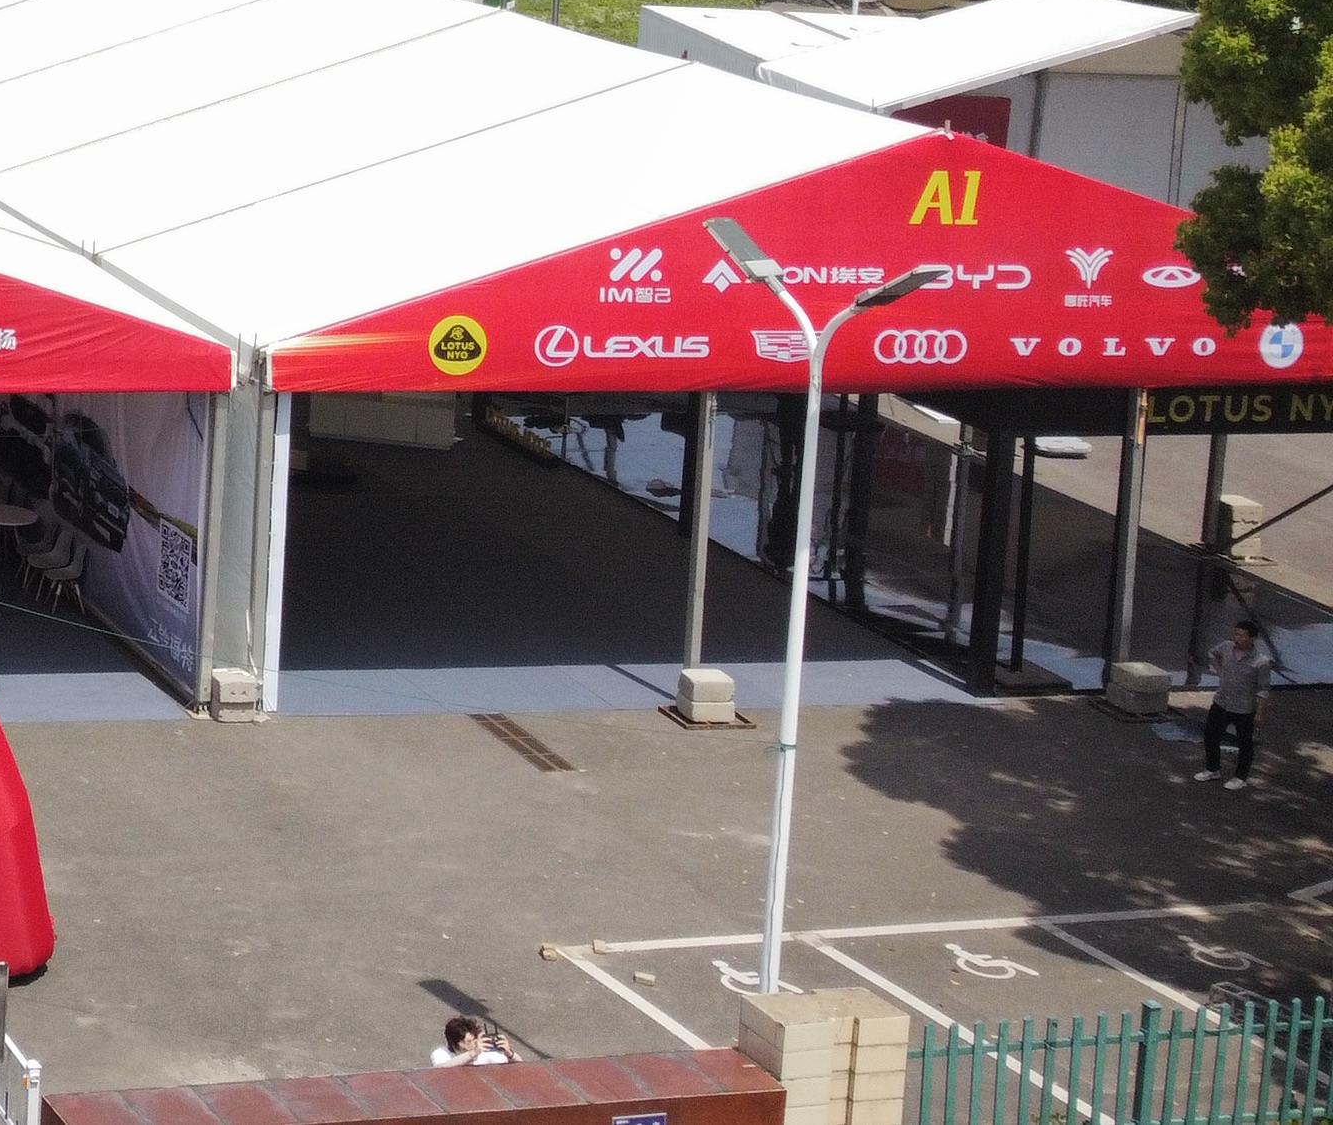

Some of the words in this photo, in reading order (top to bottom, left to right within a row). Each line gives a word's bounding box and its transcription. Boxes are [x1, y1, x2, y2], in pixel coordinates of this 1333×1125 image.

[909, 170, 982, 225] A1
[440, 341, 475, 350] LOTUS
[446, 351, 469, 359] NYO
[583, 336, 710, 359] LEXUS
[1010, 337, 1217, 357] VOLVO
[1146, 394, 1273, 424] LOTUS
